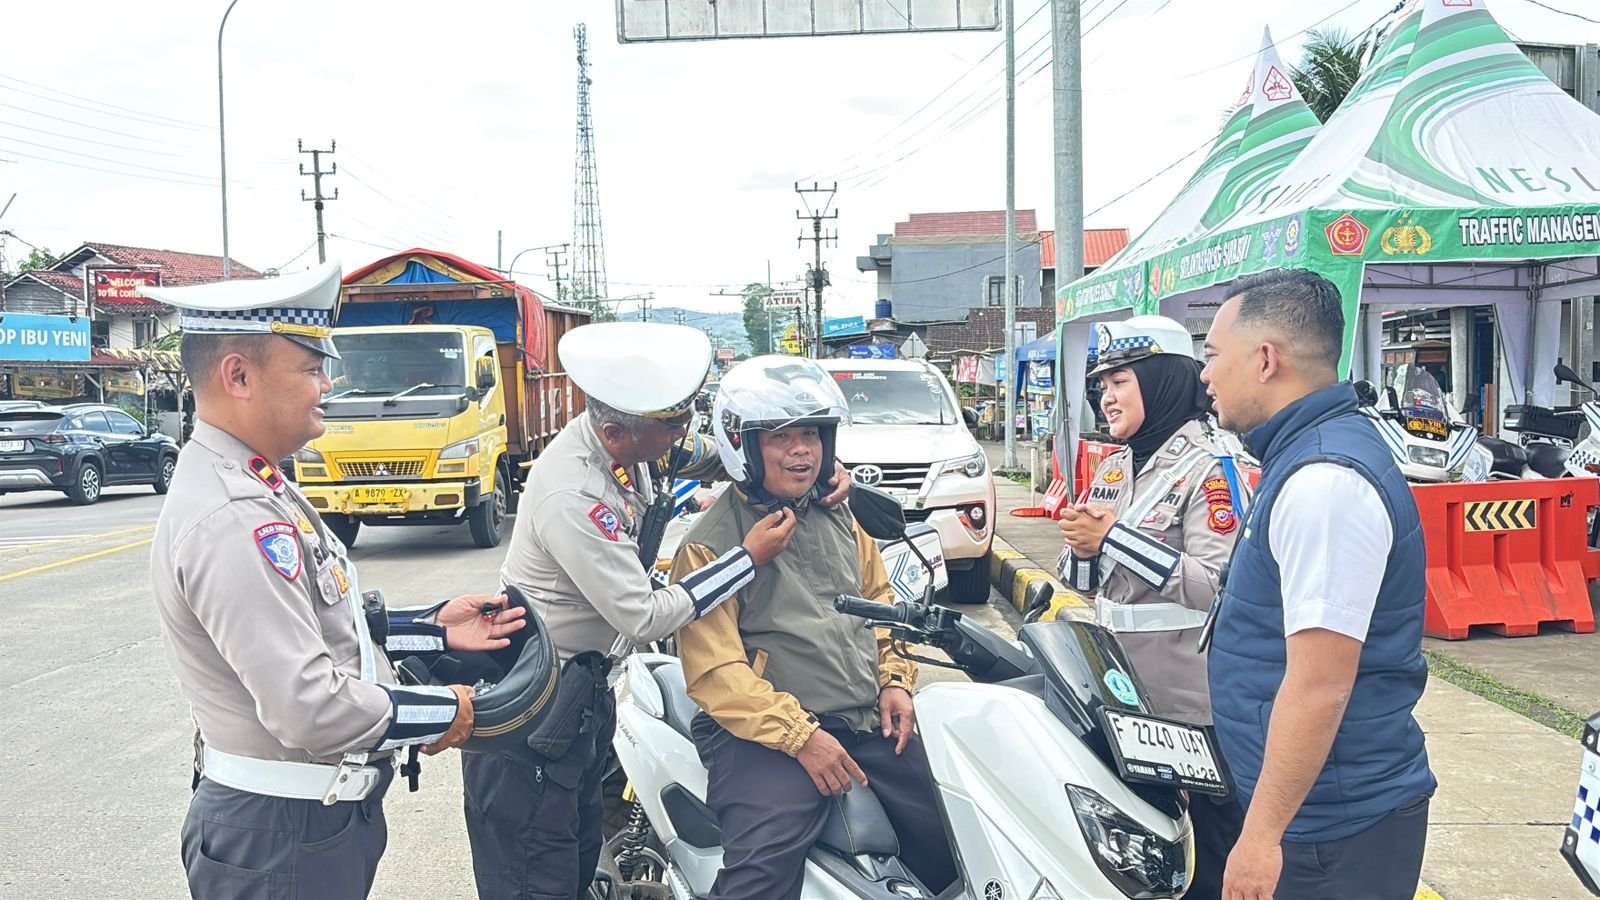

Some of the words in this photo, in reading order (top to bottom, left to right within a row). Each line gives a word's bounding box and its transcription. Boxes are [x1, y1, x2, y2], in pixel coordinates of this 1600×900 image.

[1458, 217, 1523, 247] TRAFFIC
[110, 278, 145, 287] WELCOME
[98, 289, 107, 297] TO
[107, 288, 118, 298] THE
[21, 329, 48, 346] IBU
[52, 330, 87, 346] YENI
[355, 489, 360, 497] A
[365, 488, 386, 498] 9879
[393, 488, 404, 498] ZX
[1092, 487, 1119, 502] RANI
[1112, 717, 1124, 740] F
[1132, 721, 1175, 750] 2240
[1177, 730, 1208, 758] UAY
[1133, 764, 1157, 776] YAMAHA
